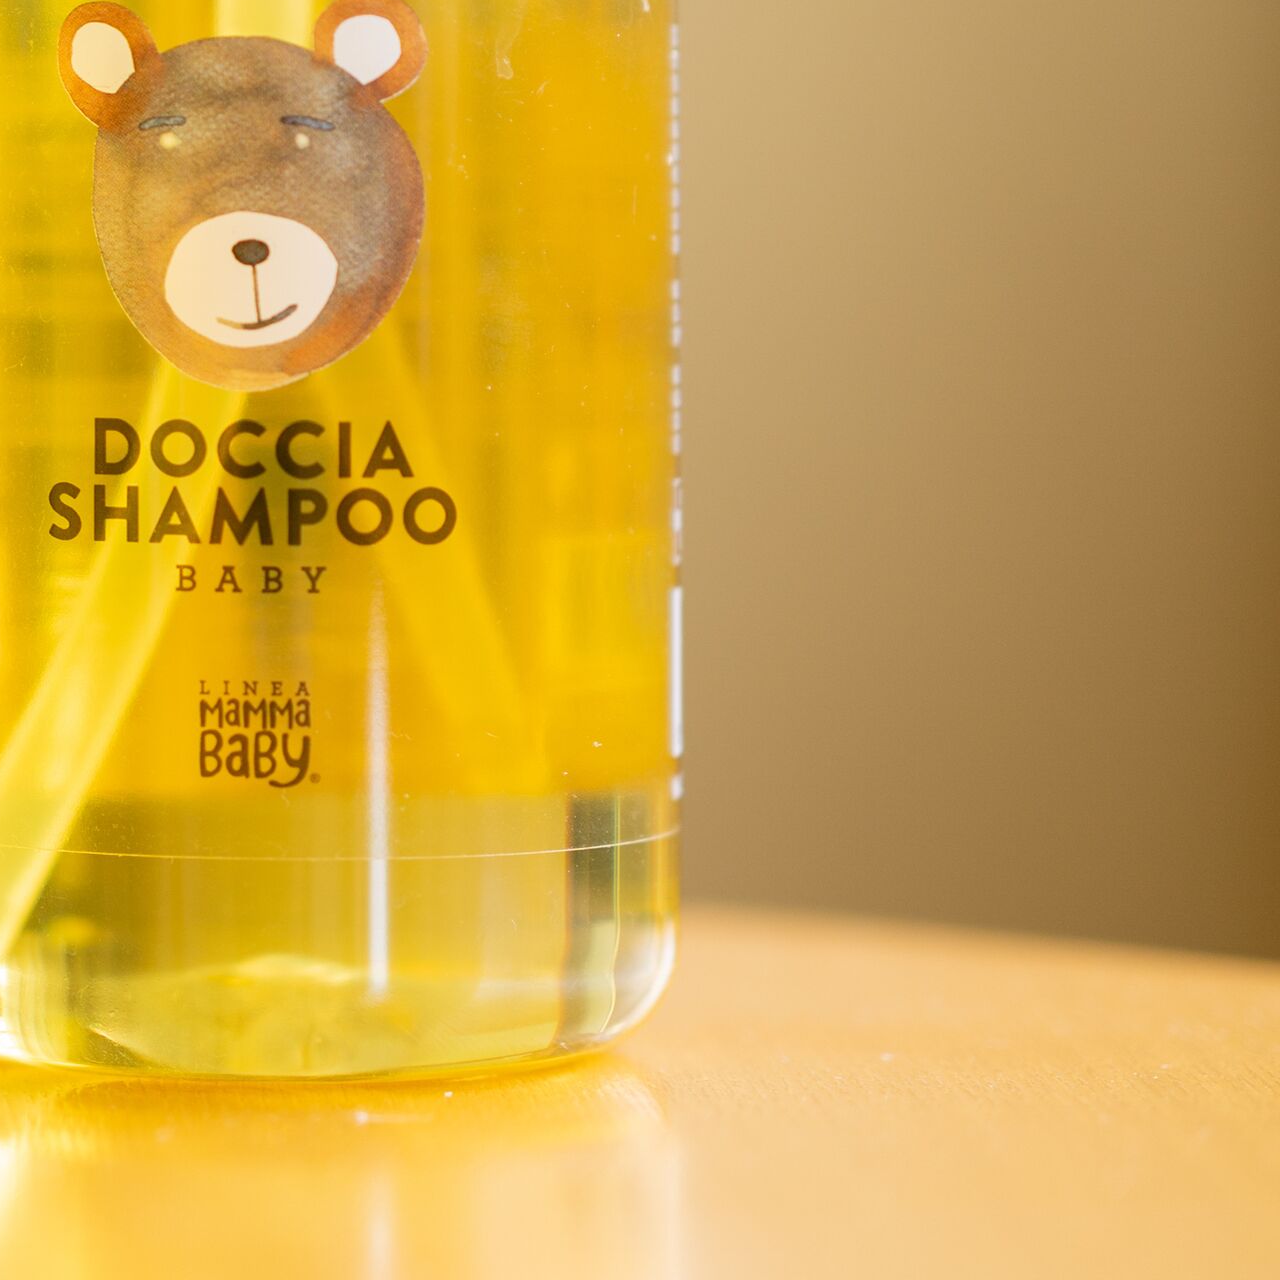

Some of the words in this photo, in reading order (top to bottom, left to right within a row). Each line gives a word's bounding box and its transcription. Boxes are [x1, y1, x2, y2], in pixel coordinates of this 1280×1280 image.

[93, 417, 414, 480] DOCCIA
[48, 481, 457, 546] SHAMPOO
[175, 564, 327, 594] BABY
[199, 680, 310, 697] LINEA
